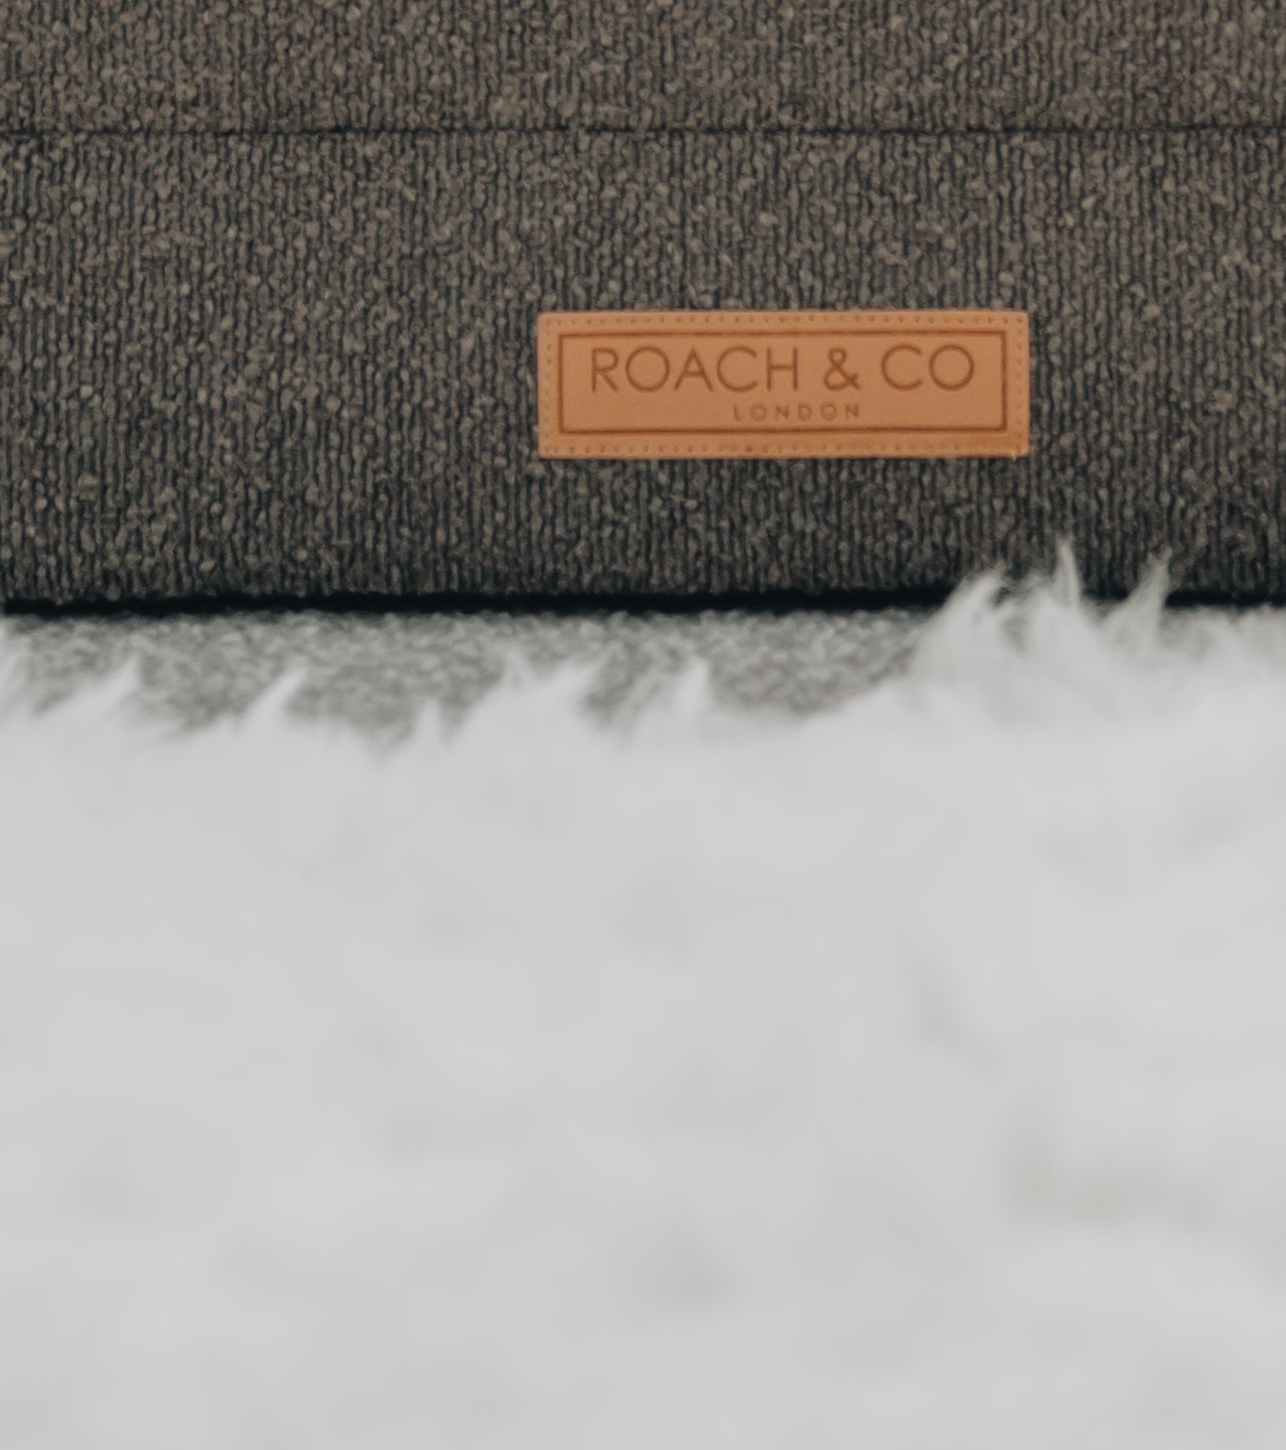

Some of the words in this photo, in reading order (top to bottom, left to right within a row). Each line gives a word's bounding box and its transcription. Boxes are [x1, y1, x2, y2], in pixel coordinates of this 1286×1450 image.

[590, 346, 800, 393] ROACH
[822, 346, 861, 392] &
[880, 344, 976, 392] CO
[733, 403, 861, 422] LONDON
